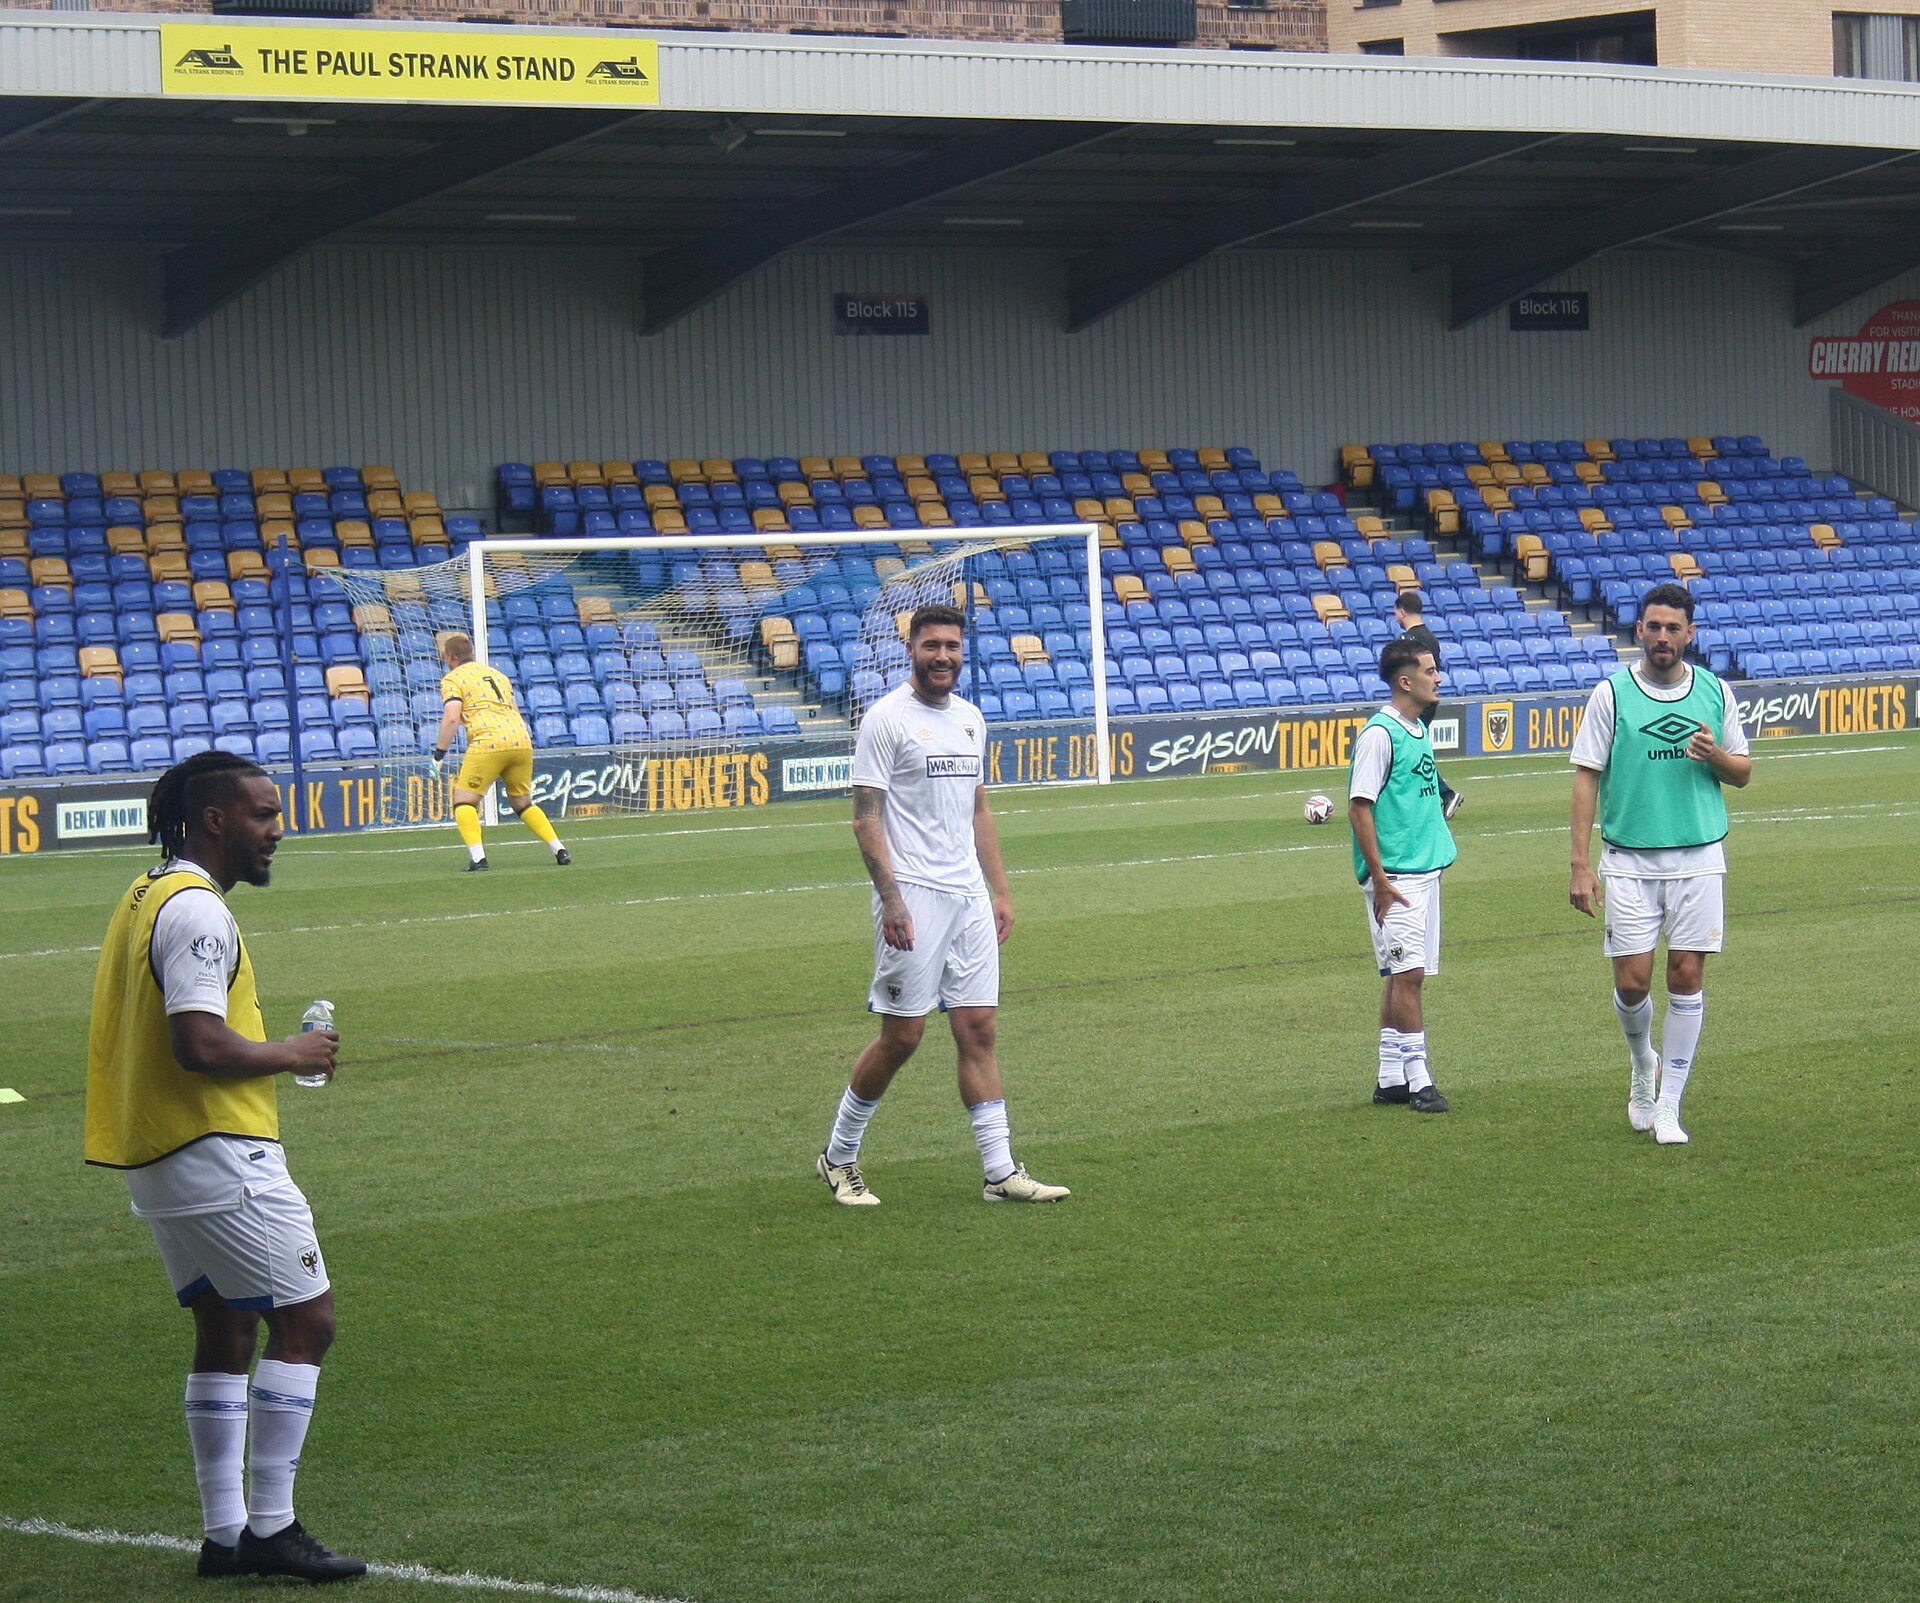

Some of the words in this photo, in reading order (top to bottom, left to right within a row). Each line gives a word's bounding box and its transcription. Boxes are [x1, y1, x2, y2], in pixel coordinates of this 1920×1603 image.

[258, 48, 308, 74] THE
[316, 50, 381, 77] PAUL
[388, 52, 489, 80] STRANK
[496, 55, 576, 82] STAND
[847, 301, 892, 318] Block
[896, 302, 918, 318] 115
[1520, 299, 1558, 315] Block
[1561, 300, 1580, 315] 116
[1870, 326, 1890, 337] FOR
[1811, 341, 1885, 374] CHERRY
[1886, 340, 1920, 373] RED
[482, 676, 505, 703] 1
[763, 681, 770, 691] E
[808, 709, 817, 719] D
[1738, 687, 1820, 738] EASON
[1817, 684, 1906, 735] TICKETS
[1432, 726, 1456, 743] NOW!
[1146, 719, 1280, 775] SEASON
[929, 760, 954, 773] WAR
[1014, 736, 1058, 783] THE
[646, 752, 769, 812] TICKETS
[789, 764, 824, 785] RENEW
[339, 775, 394, 827] THE
[65, 809, 107, 830] RENEW
[111, 807, 142, 828] NOW!
